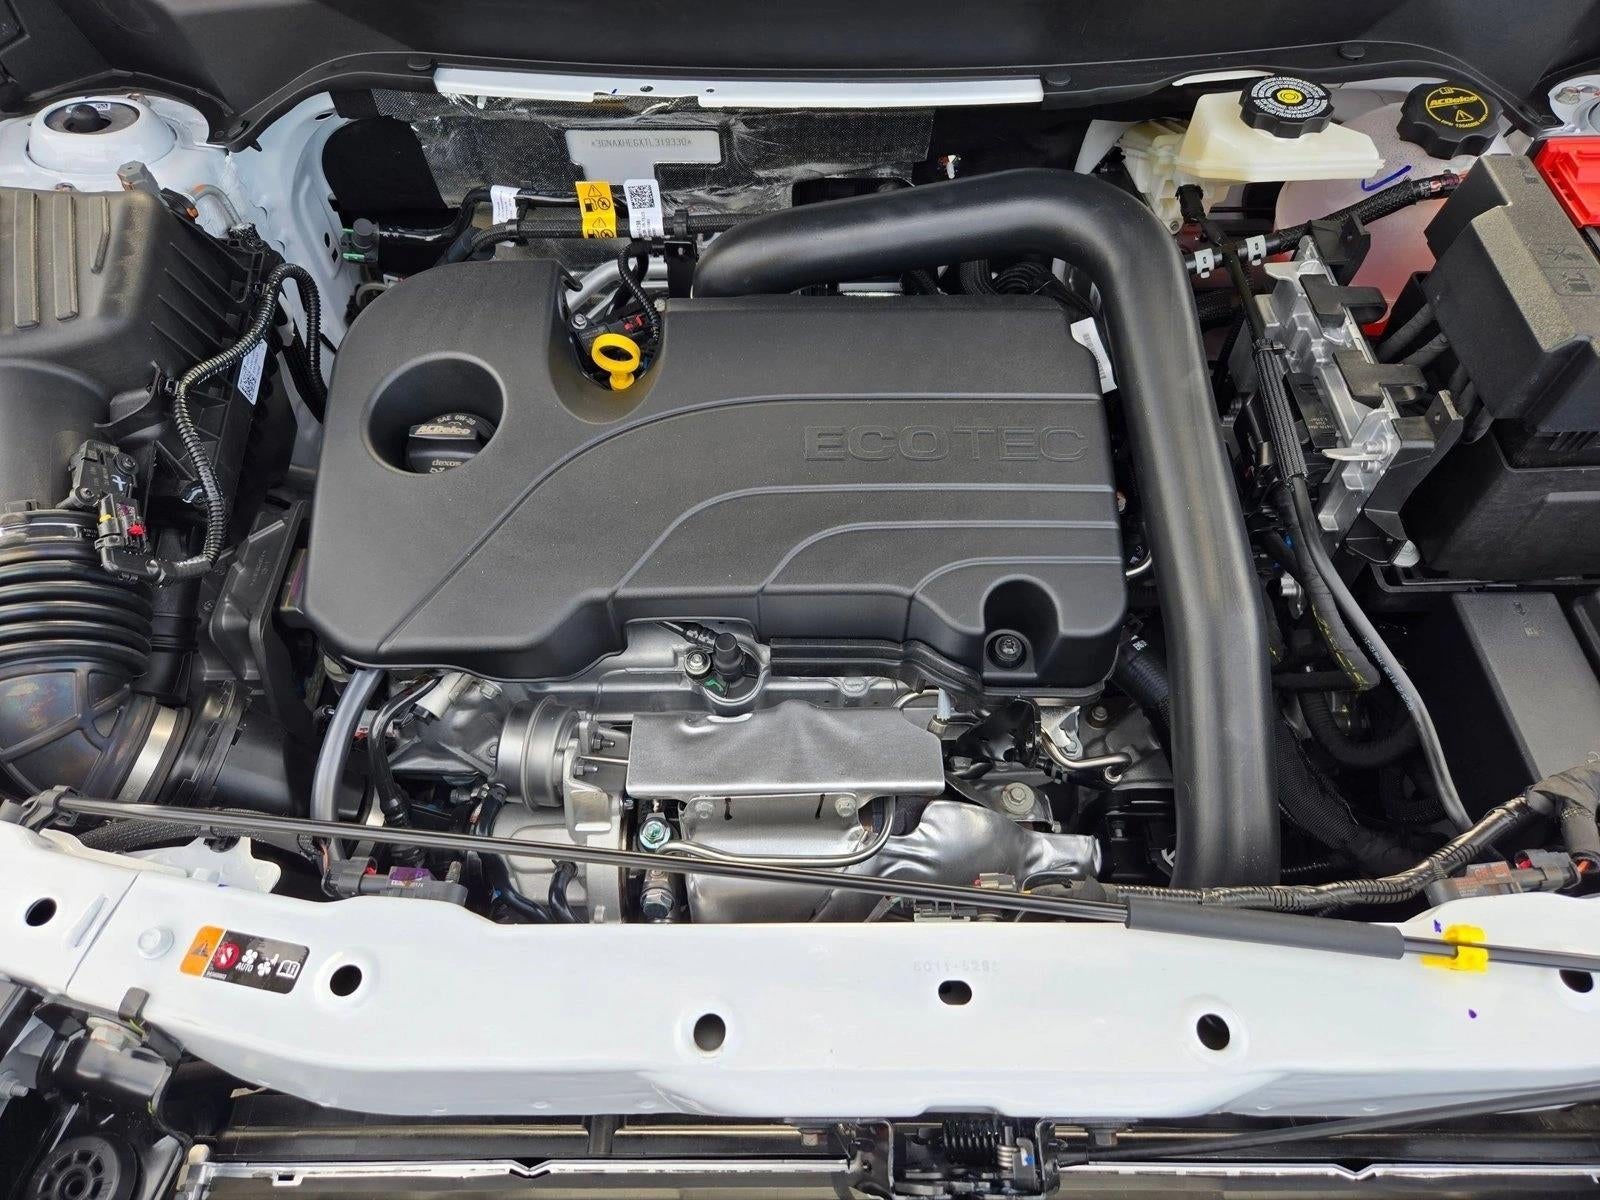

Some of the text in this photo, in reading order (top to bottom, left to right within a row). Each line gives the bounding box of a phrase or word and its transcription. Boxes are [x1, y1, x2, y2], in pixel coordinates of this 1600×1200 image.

[437, 414, 477, 426] SAE 0W-20
[803, 424, 1089, 462] ECOTEC
[431, 459, 464, 468] dexos
[235, 961, 255, 972] AUTO
